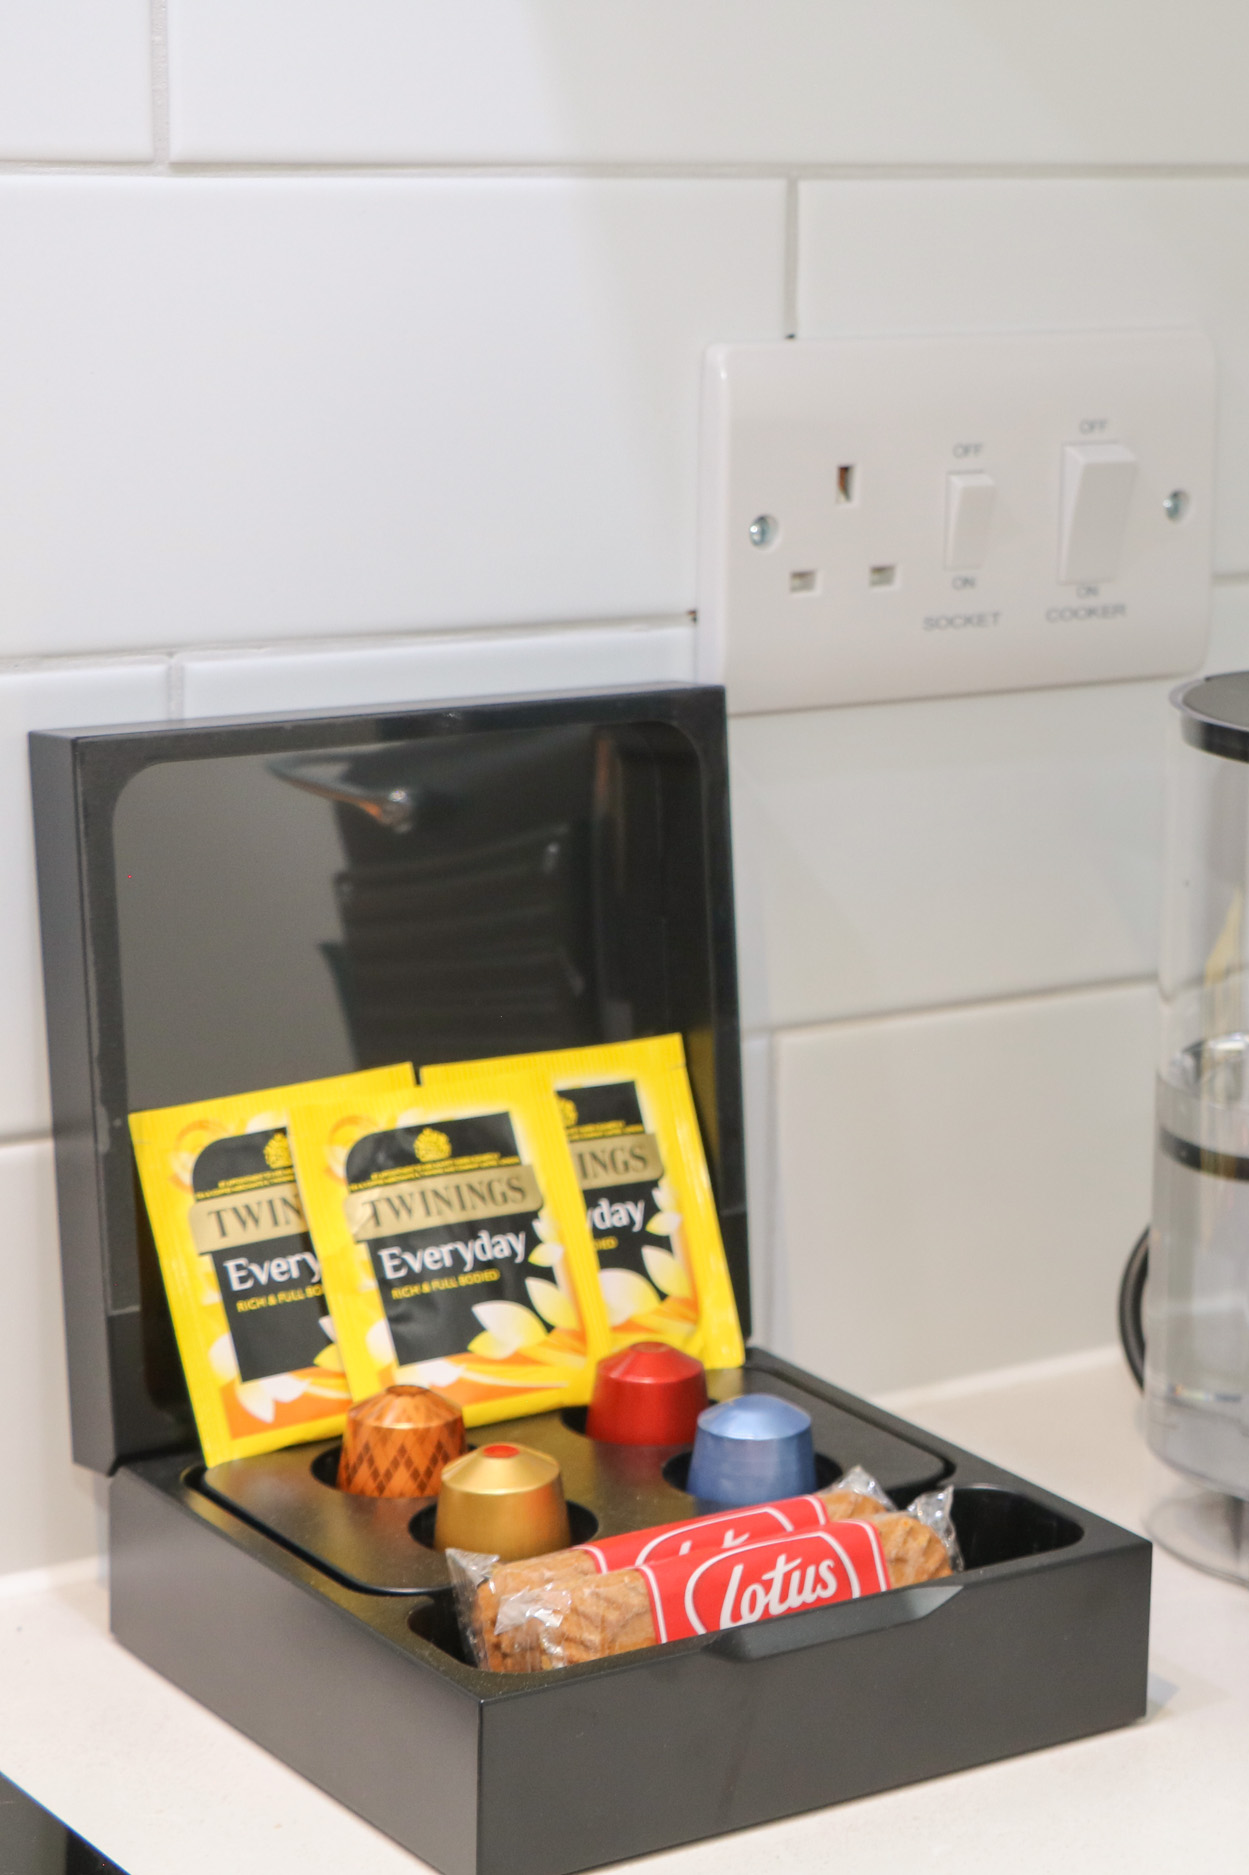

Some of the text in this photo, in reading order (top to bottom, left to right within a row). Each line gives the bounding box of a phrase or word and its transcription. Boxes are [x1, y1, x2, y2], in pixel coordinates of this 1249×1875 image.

[1079, 419, 1107, 435] OFF
[953, 443, 983, 459] OFF
[952, 576, 976, 590] ON
[1076, 585, 1099, 599] ON
[923, 612, 1002, 632] SOCKET
[1046, 604, 1127, 624] COOKER
[577, 1144, 648, 1180] INGS
[362, 1175, 527, 1228] TWININGS
[207, 1193, 305, 1239] TWIN
[377, 1229, 526, 1280] Everyday
[222, 1251, 322, 1292] Every
[391, 1281, 421, 1300] RICH
[431, 1275, 459, 1291] FULL
[458, 1269, 501, 1286] BODIED
[236, 1296, 268, 1313] RICH
[277, 1288, 305, 1304] FULL
